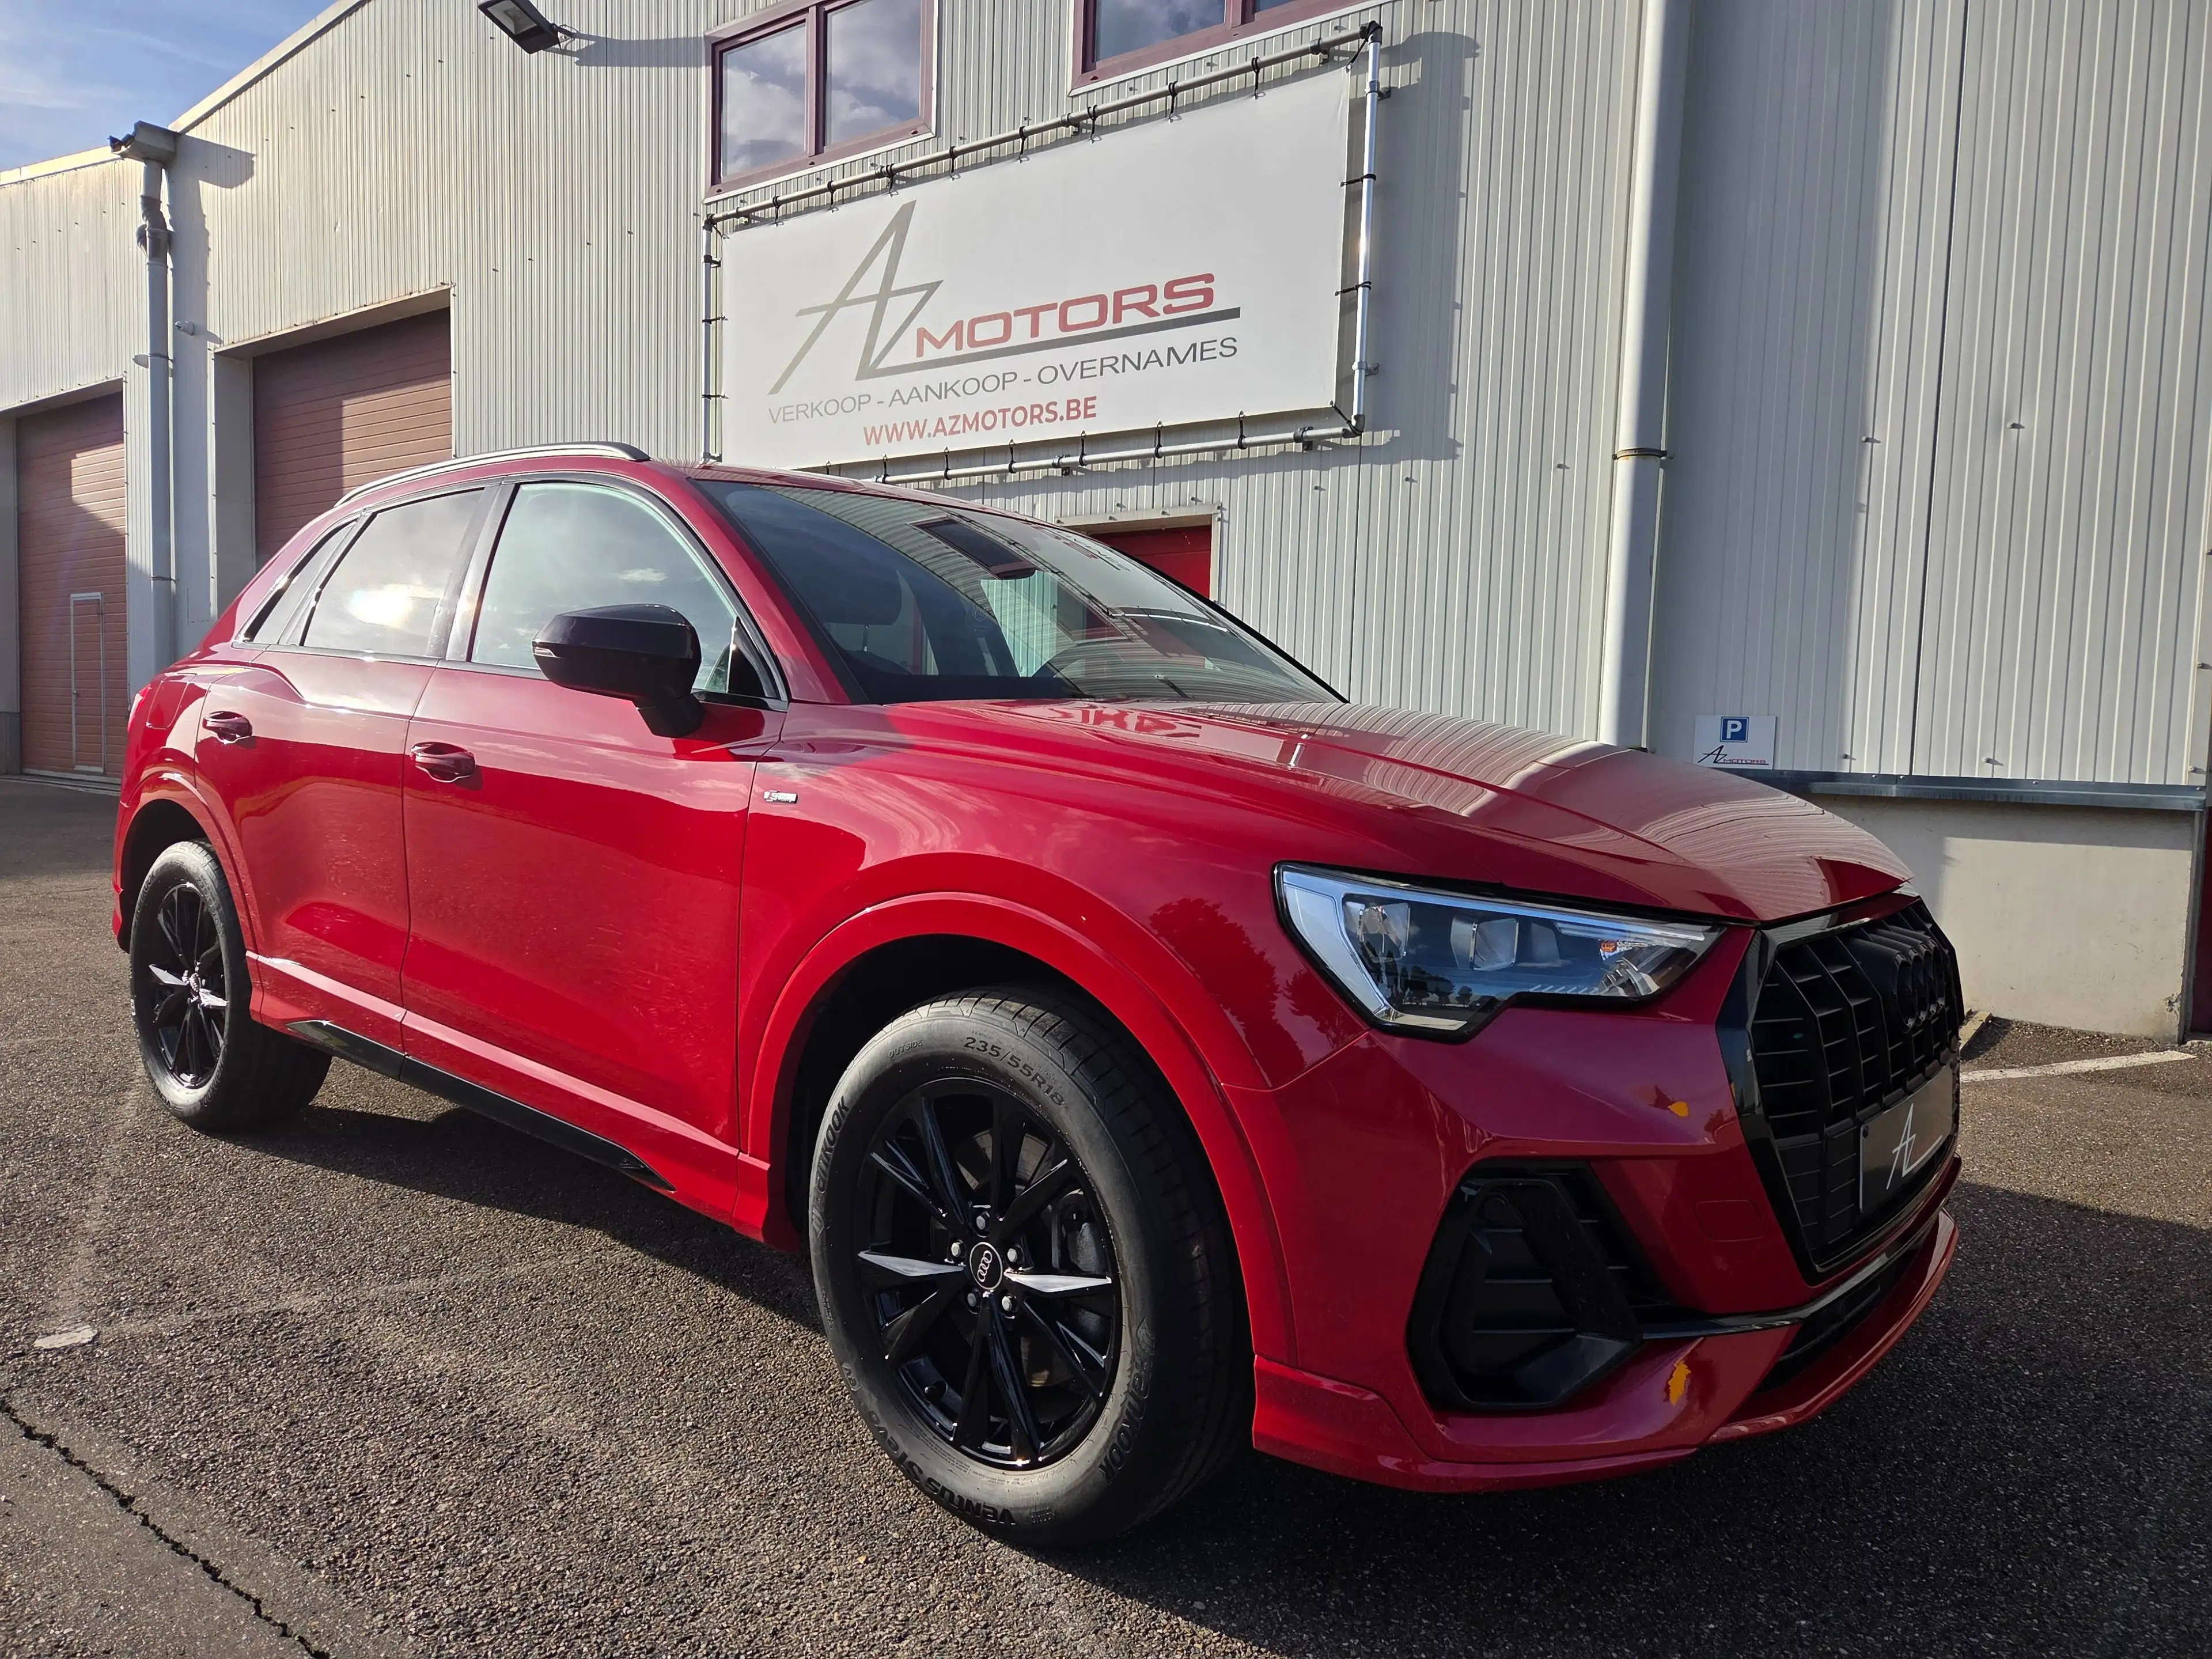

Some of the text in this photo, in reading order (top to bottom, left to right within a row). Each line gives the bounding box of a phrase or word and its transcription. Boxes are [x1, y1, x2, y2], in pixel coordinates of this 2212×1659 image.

[767, 199, 1215, 395] AZ MOTORS
[768, 394, 872, 424] VERKOOP
[888, 371, 1018, 408] AANKOOP
[1037, 337, 1238, 385] OVERNAMES
[863, 396, 1097, 446] WWW.AZMOTORS.BE
[1726, 720, 1742, 739] P
[888, 1039, 923, 1059] OUTSIDE
[964, 1036, 1065, 1106] 235/55R18
